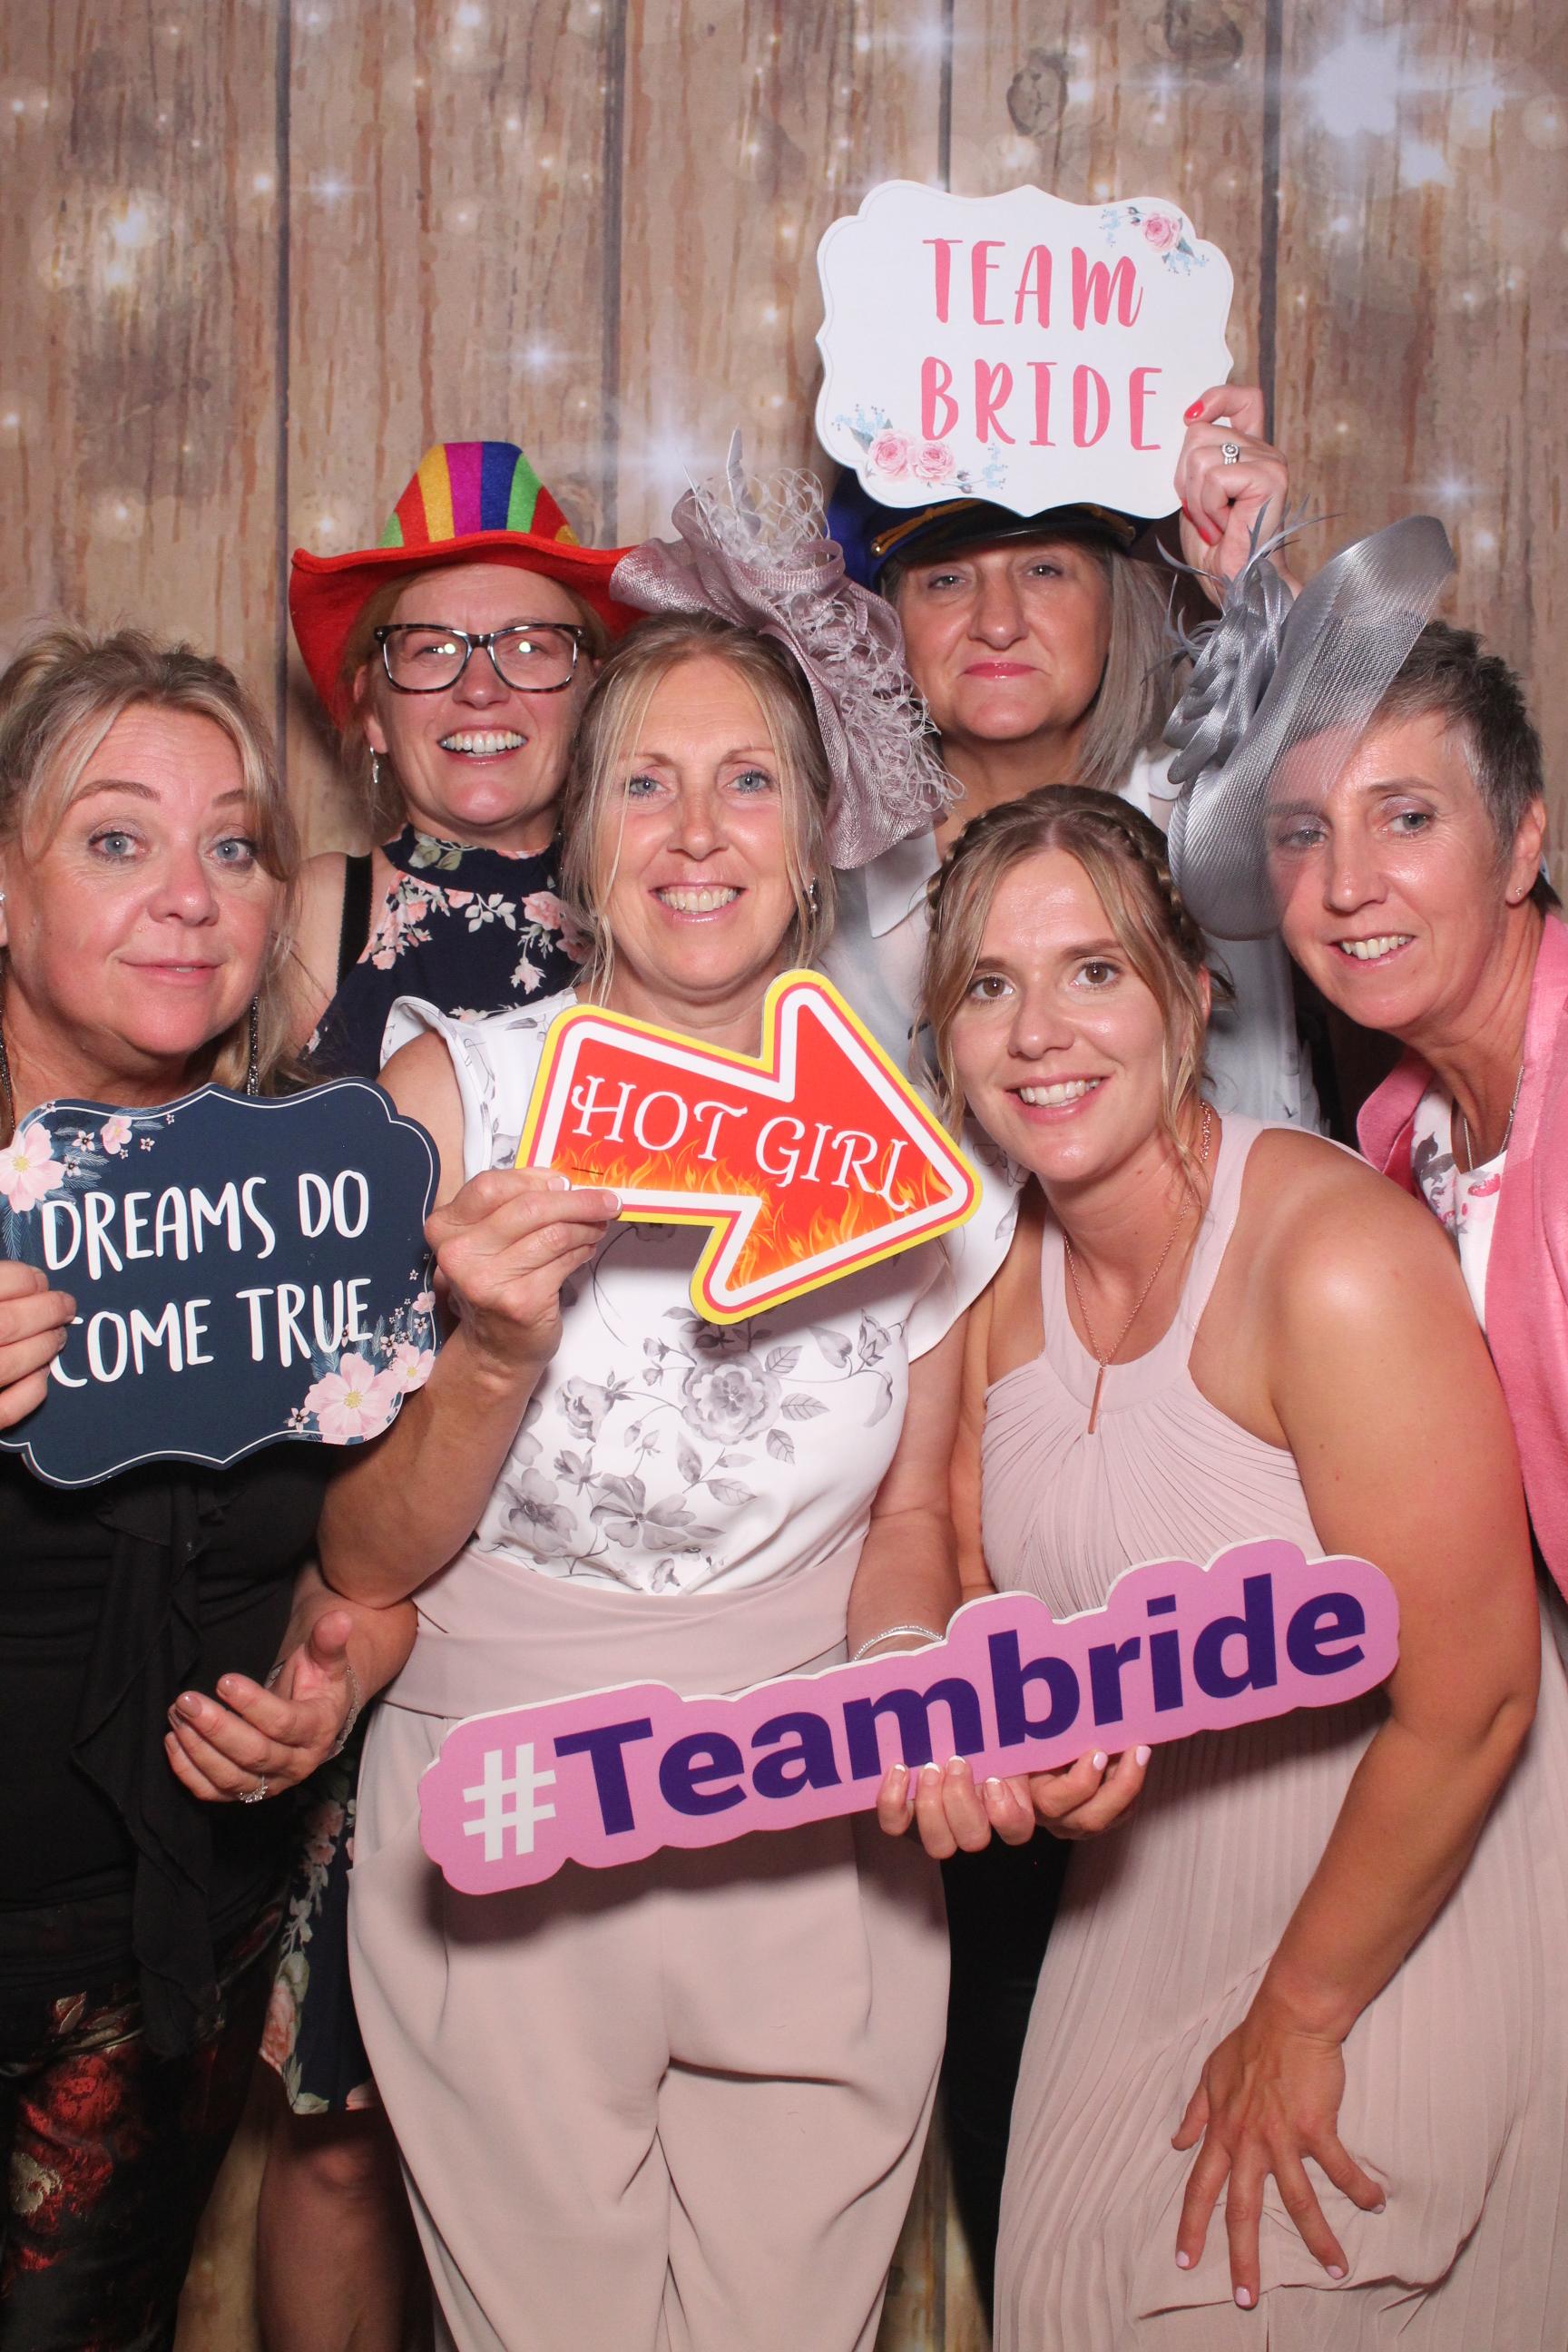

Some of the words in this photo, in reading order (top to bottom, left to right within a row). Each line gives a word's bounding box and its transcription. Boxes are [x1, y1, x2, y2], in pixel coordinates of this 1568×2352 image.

[922, 238, 1143, 331] TEAM
[920, 356, 1161, 450] BRIDE
[571, 1074, 748, 1161] HOT
[755, 1116, 910, 1211] GIRL
[42, 1176, 276, 1280] DREAMS
[298, 1170, 369, 1238] DO
[236, 1278, 374, 1367] TRUE
[462, 1573, 1366, 1862] #Teambride
